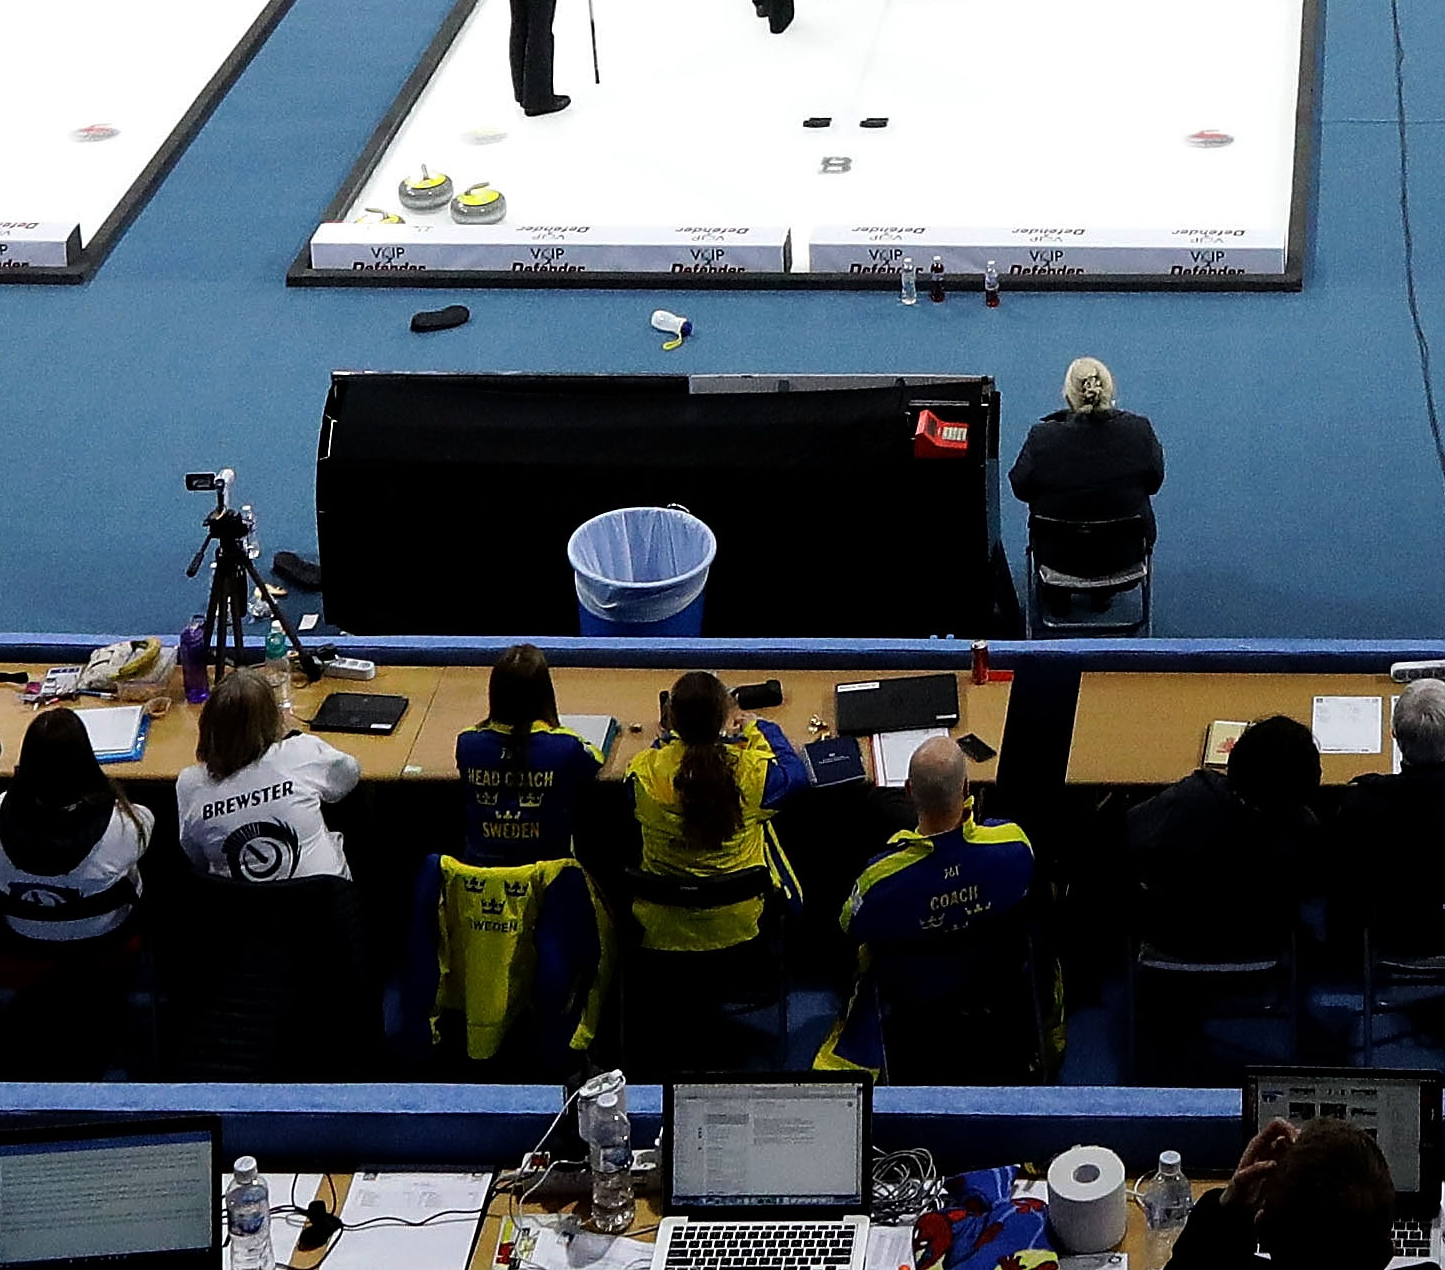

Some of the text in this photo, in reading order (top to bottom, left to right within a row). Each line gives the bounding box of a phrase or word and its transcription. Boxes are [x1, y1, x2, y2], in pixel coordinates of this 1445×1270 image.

[818, 156, 853, 175] B
[505, 771, 554, 788] CACH
[201, 780, 295, 821] BREWSTER
[482, 820, 540, 839] SWEDEN
[930, 884, 979, 910] COACH
